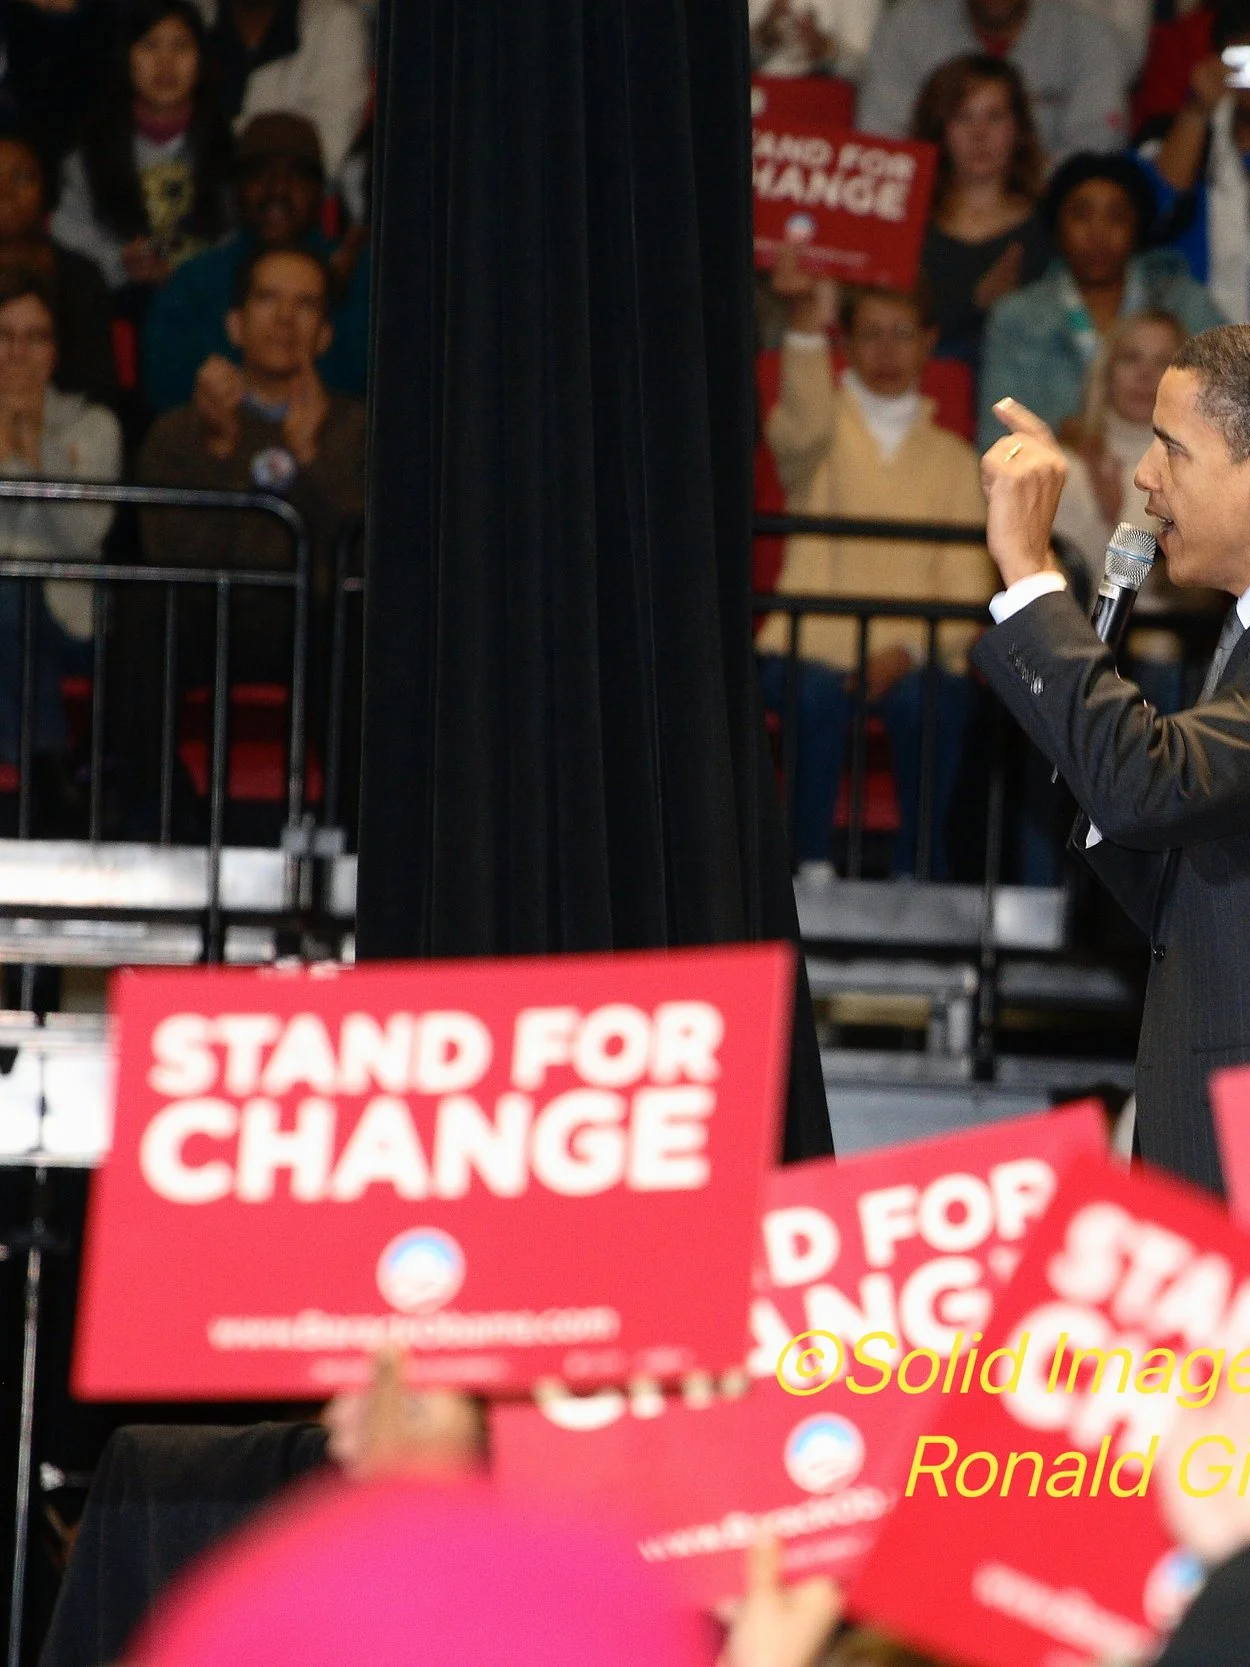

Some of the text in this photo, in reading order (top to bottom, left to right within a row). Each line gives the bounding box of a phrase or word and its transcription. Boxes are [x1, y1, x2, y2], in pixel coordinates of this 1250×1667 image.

[751, 128, 916, 178] AND FOR
[751, 160, 909, 221] HANGE
[150, 1001, 723, 1097] STAND FOR
[140, 1085, 715, 1203] CHANGE
